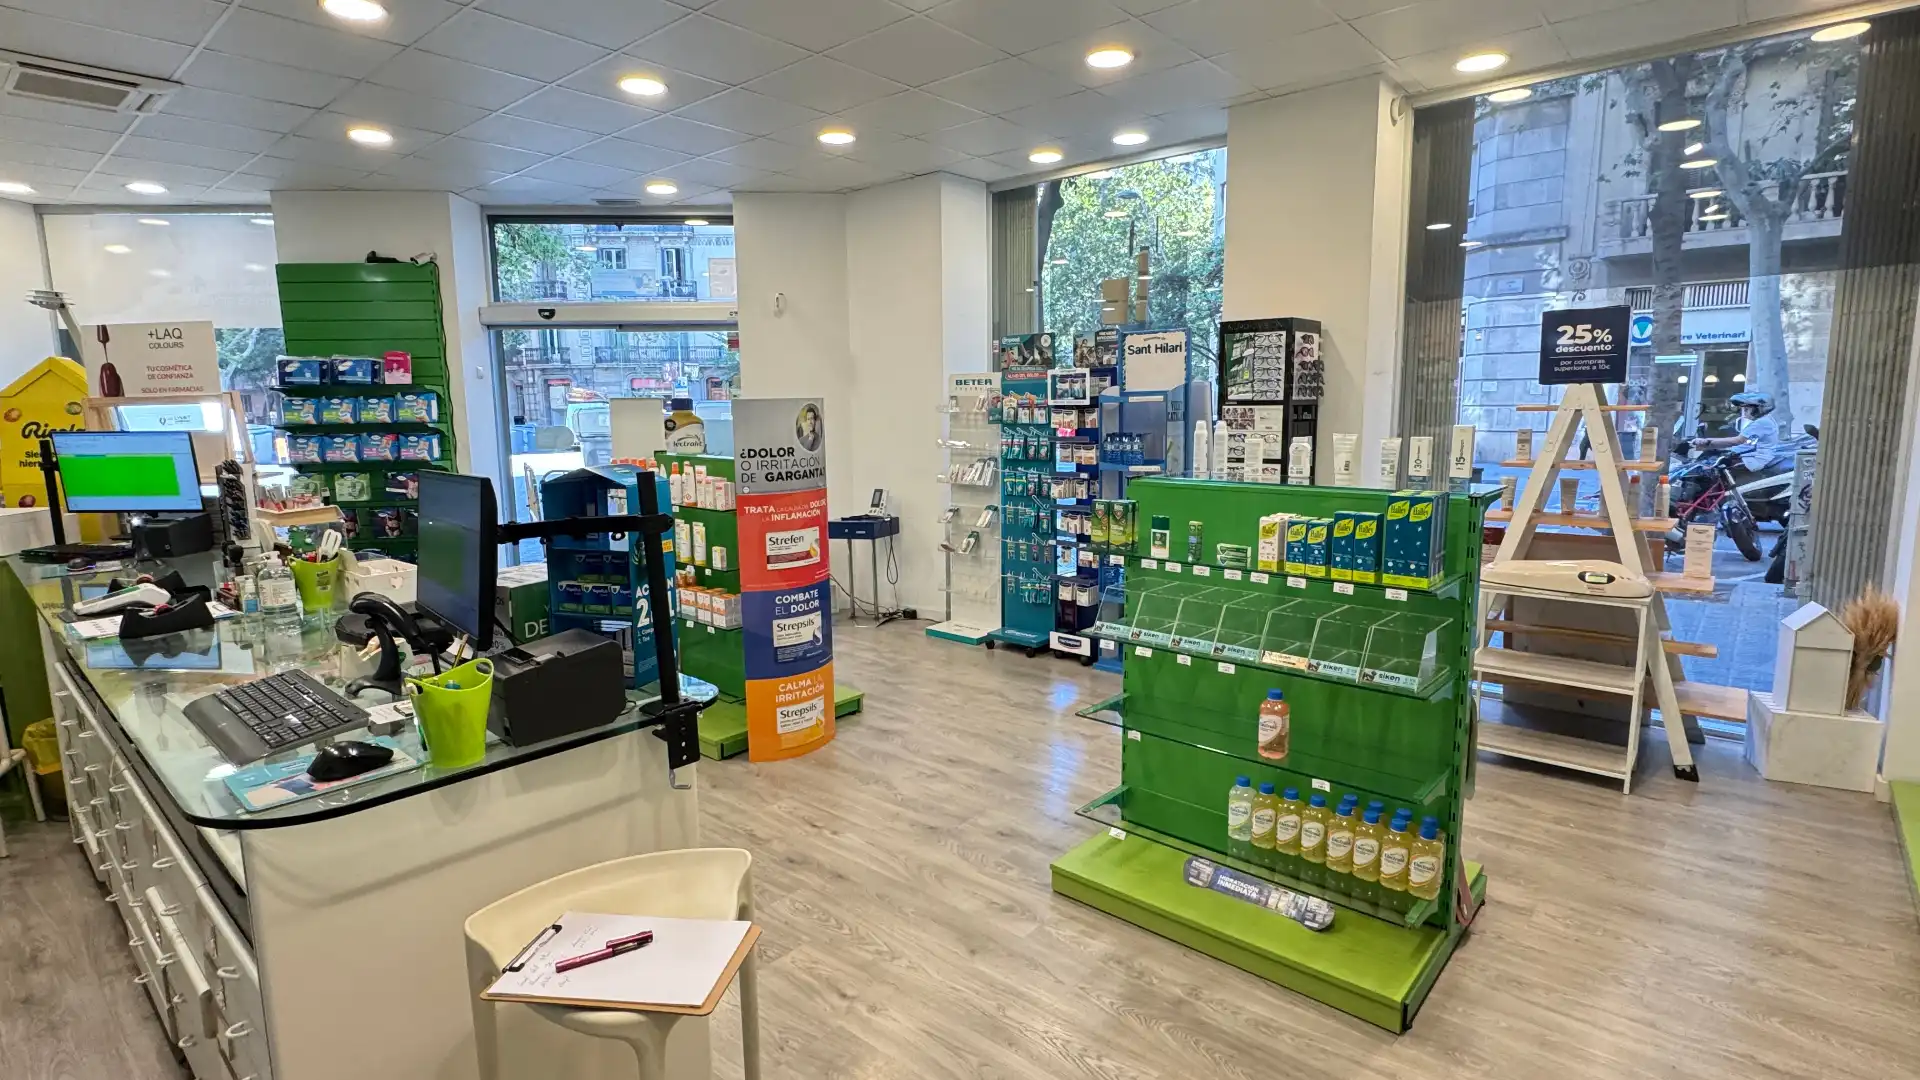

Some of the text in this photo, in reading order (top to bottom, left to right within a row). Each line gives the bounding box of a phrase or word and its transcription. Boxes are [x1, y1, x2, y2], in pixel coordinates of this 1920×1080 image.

[147, 328, 183, 340] +LAQ
[1556, 324, 1613, 345] 25%
[1696, 331, 1746, 340] Veterinari
[148, 341, 185, 350] COLOURS
[1127, 341, 1183, 355] Sant Hilari
[955, 378, 993, 386] BETER
[740, 446, 796, 459] ¿DOLOR
[740, 454, 821, 471] O IRRITACIÓN
[741, 472, 757, 484] DE
[744, 505, 776, 514] TRATA
[771, 508, 821, 522] INFLAMACIÓN
[768, 534, 805, 547] Strefen
[775, 588, 819, 605] COMBATE
[775, 599, 820, 616] EL DOLOR
[776, 618, 815, 632] Strepsils
[1227, 647, 1246, 655] siken
[1322, 663, 1344, 672] siken
[1378, 673, 1401, 682] siken
[778, 678, 812, 693] CALMA
[775, 682, 825, 704] IRRITACIÓN
[780, 702, 818, 719] Strepsils
